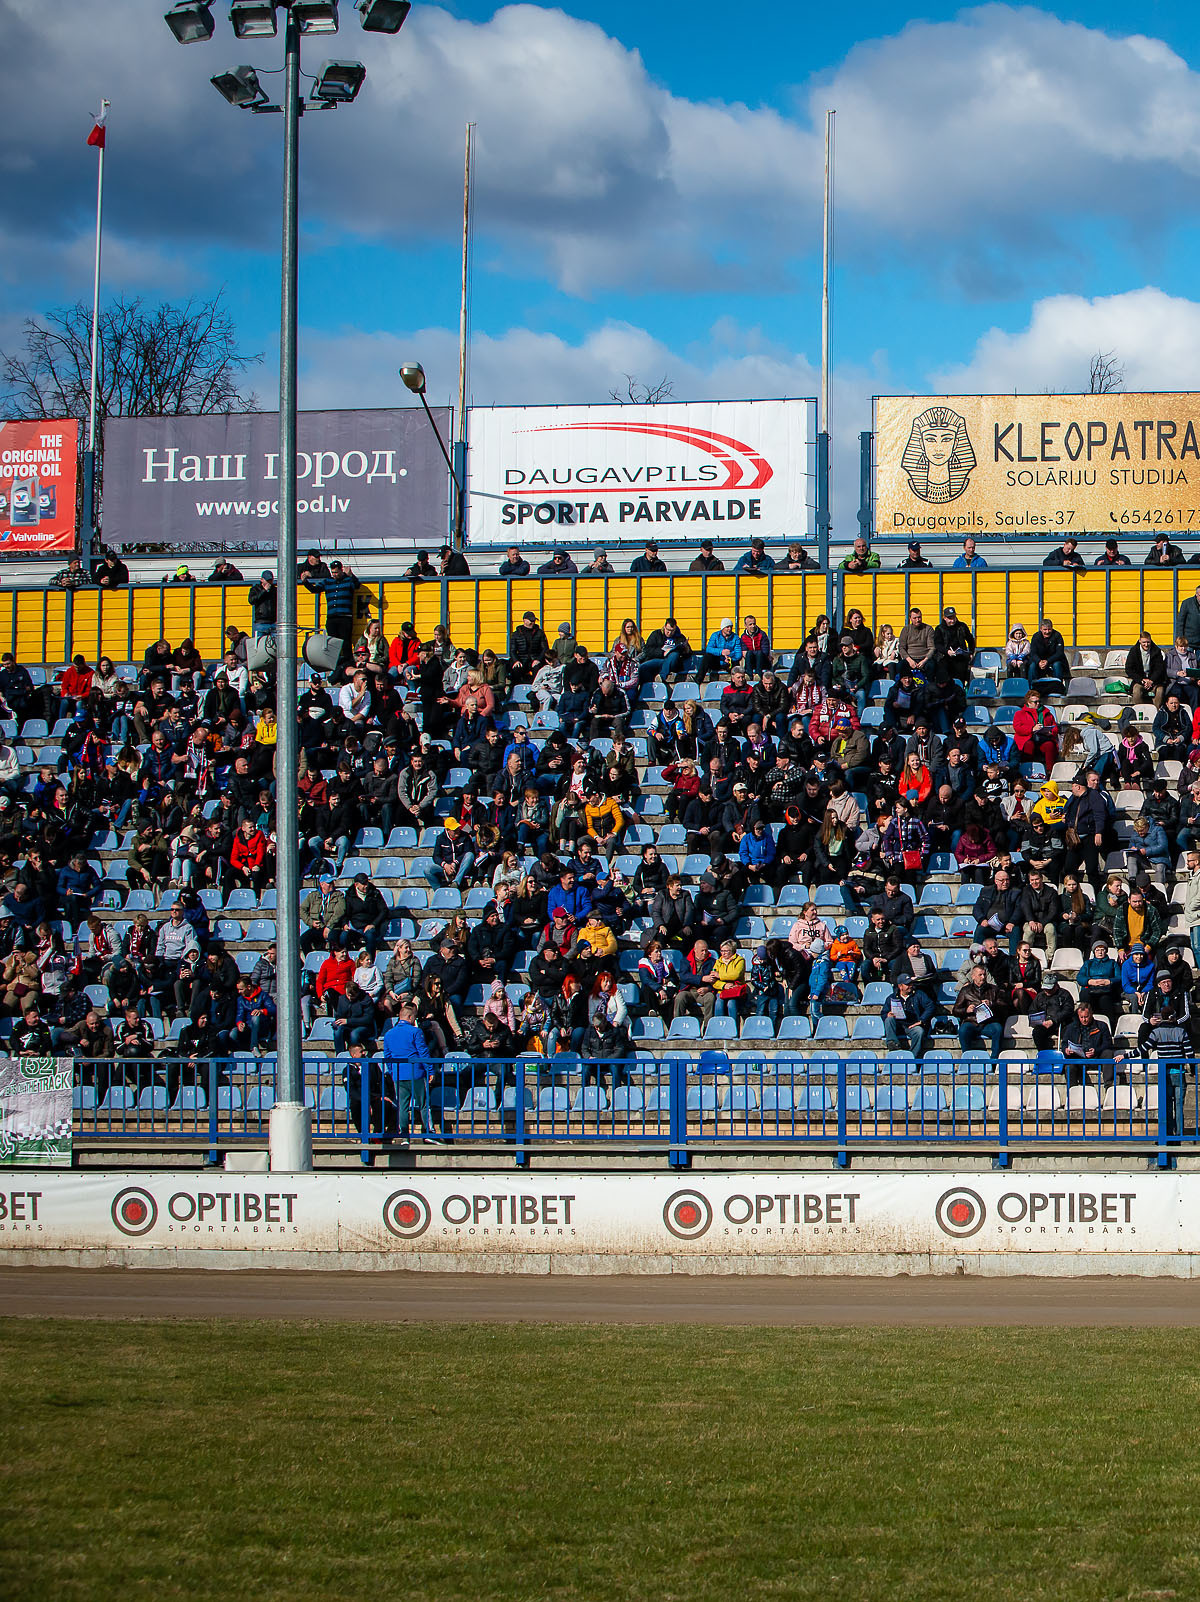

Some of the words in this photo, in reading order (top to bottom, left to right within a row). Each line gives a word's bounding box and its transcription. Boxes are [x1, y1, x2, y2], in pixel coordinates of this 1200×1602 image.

[40, 434, 63, 448] THE
[994, 420, 1200, 463] KLEOPATRA
[1, 449, 62, 463] ORIGINAL
[141, 447, 247, 483] Наш
[0, 464, 38, 477] OTOR
[41, 463, 62, 477] OIL
[504, 464, 718, 486] DAUGAVPILS
[1006, 467, 1097, 487] SOLĀRIJU
[1109, 468, 1188, 486] STUDIJA
[195, 494, 351, 518] www.good.lv
[501, 502, 610, 526] SPORTA
[619, 495, 762, 524] PĀRVALDE
[892, 511, 989, 531] Daugavpils,
[994, 510, 1076, 527] Saules-37
[25, 1056, 54, 1075] 52
[38, 1070, 72, 1092] TRACK
[169, 1192, 297, 1222] OPTIBET
[442, 1195, 575, 1224] OPTIBET
[724, 1194, 860, 1224] OPTIBET
[997, 1193, 1136, 1222] OPTIBET
[254, 1223, 297, 1233] BĀRS
[529, 1226, 577, 1235] BĀRS
[814, 1224, 860, 1234] BĀRS
[1089, 1224, 1135, 1233] BĀRS
